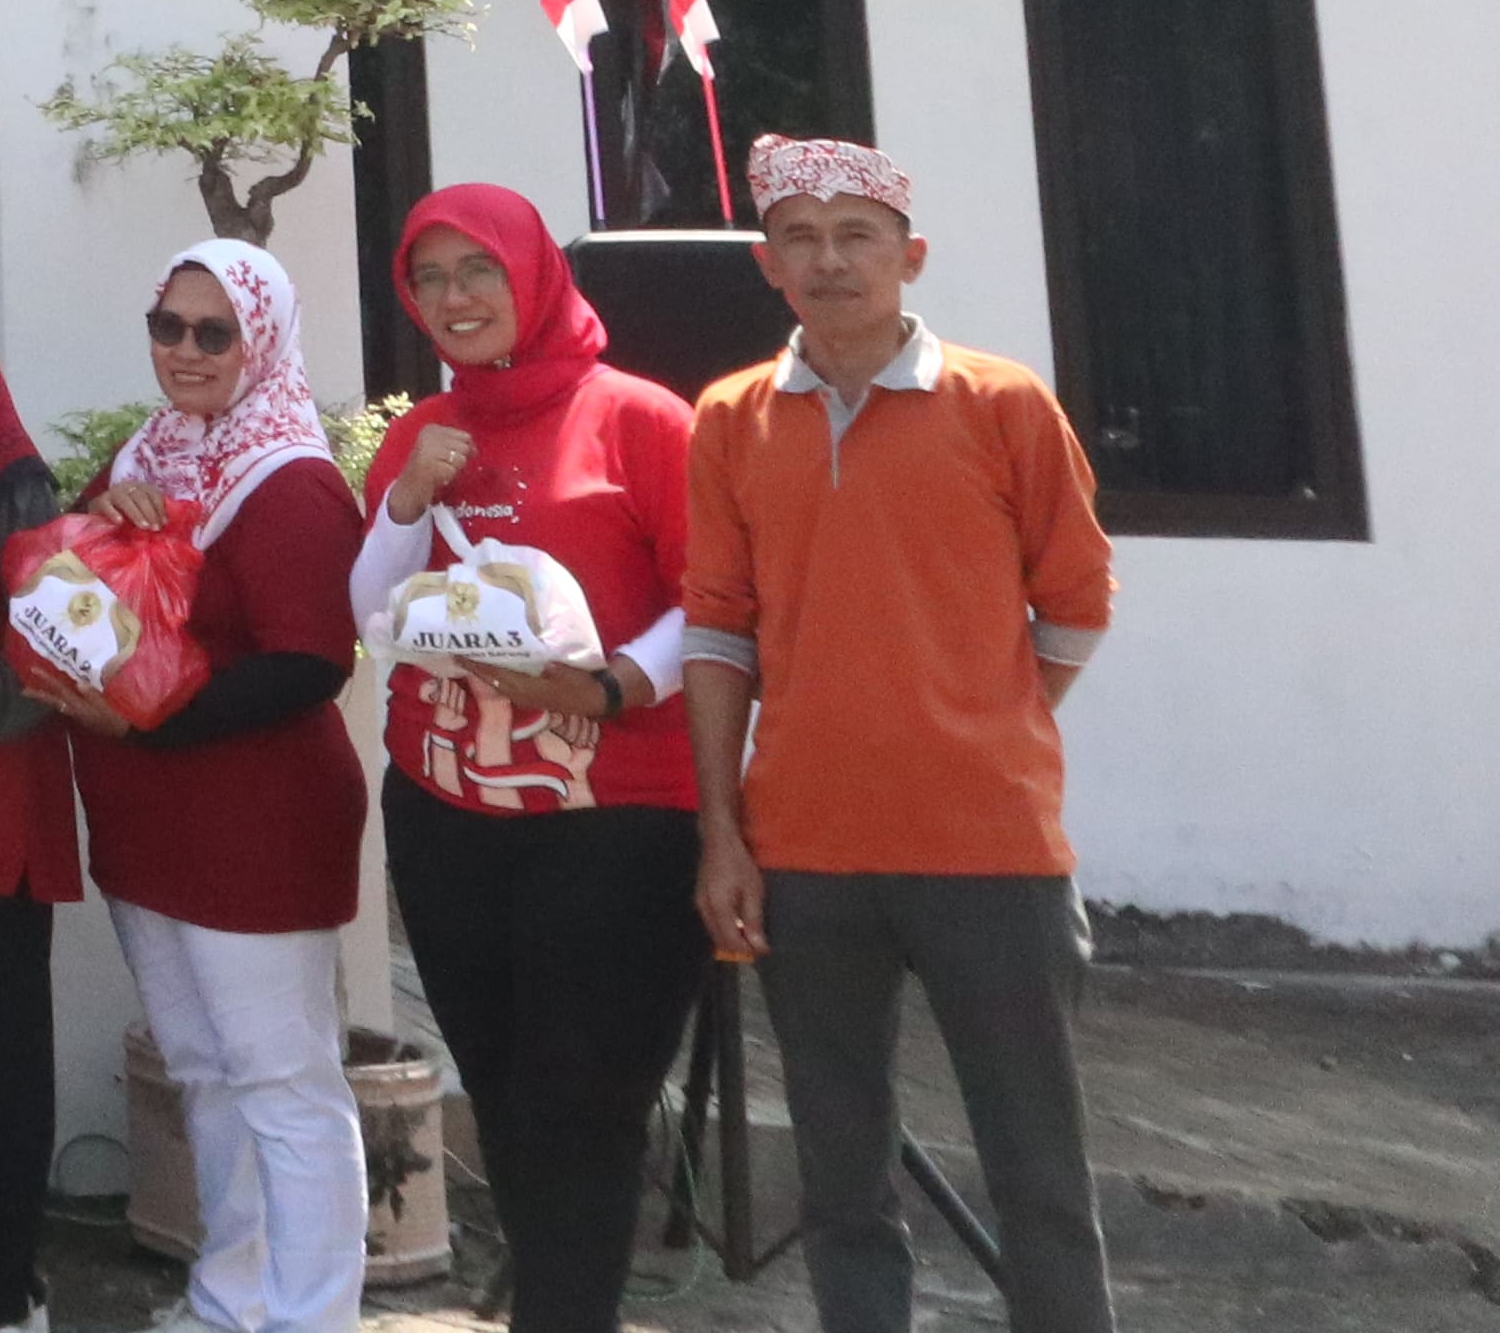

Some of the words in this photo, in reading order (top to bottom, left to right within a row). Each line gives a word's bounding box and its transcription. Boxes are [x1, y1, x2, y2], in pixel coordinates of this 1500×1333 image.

[24, 605, 78, 662] JUARA
[412, 631, 503, 649] JUARA
[506, 630, 523, 648] 3
